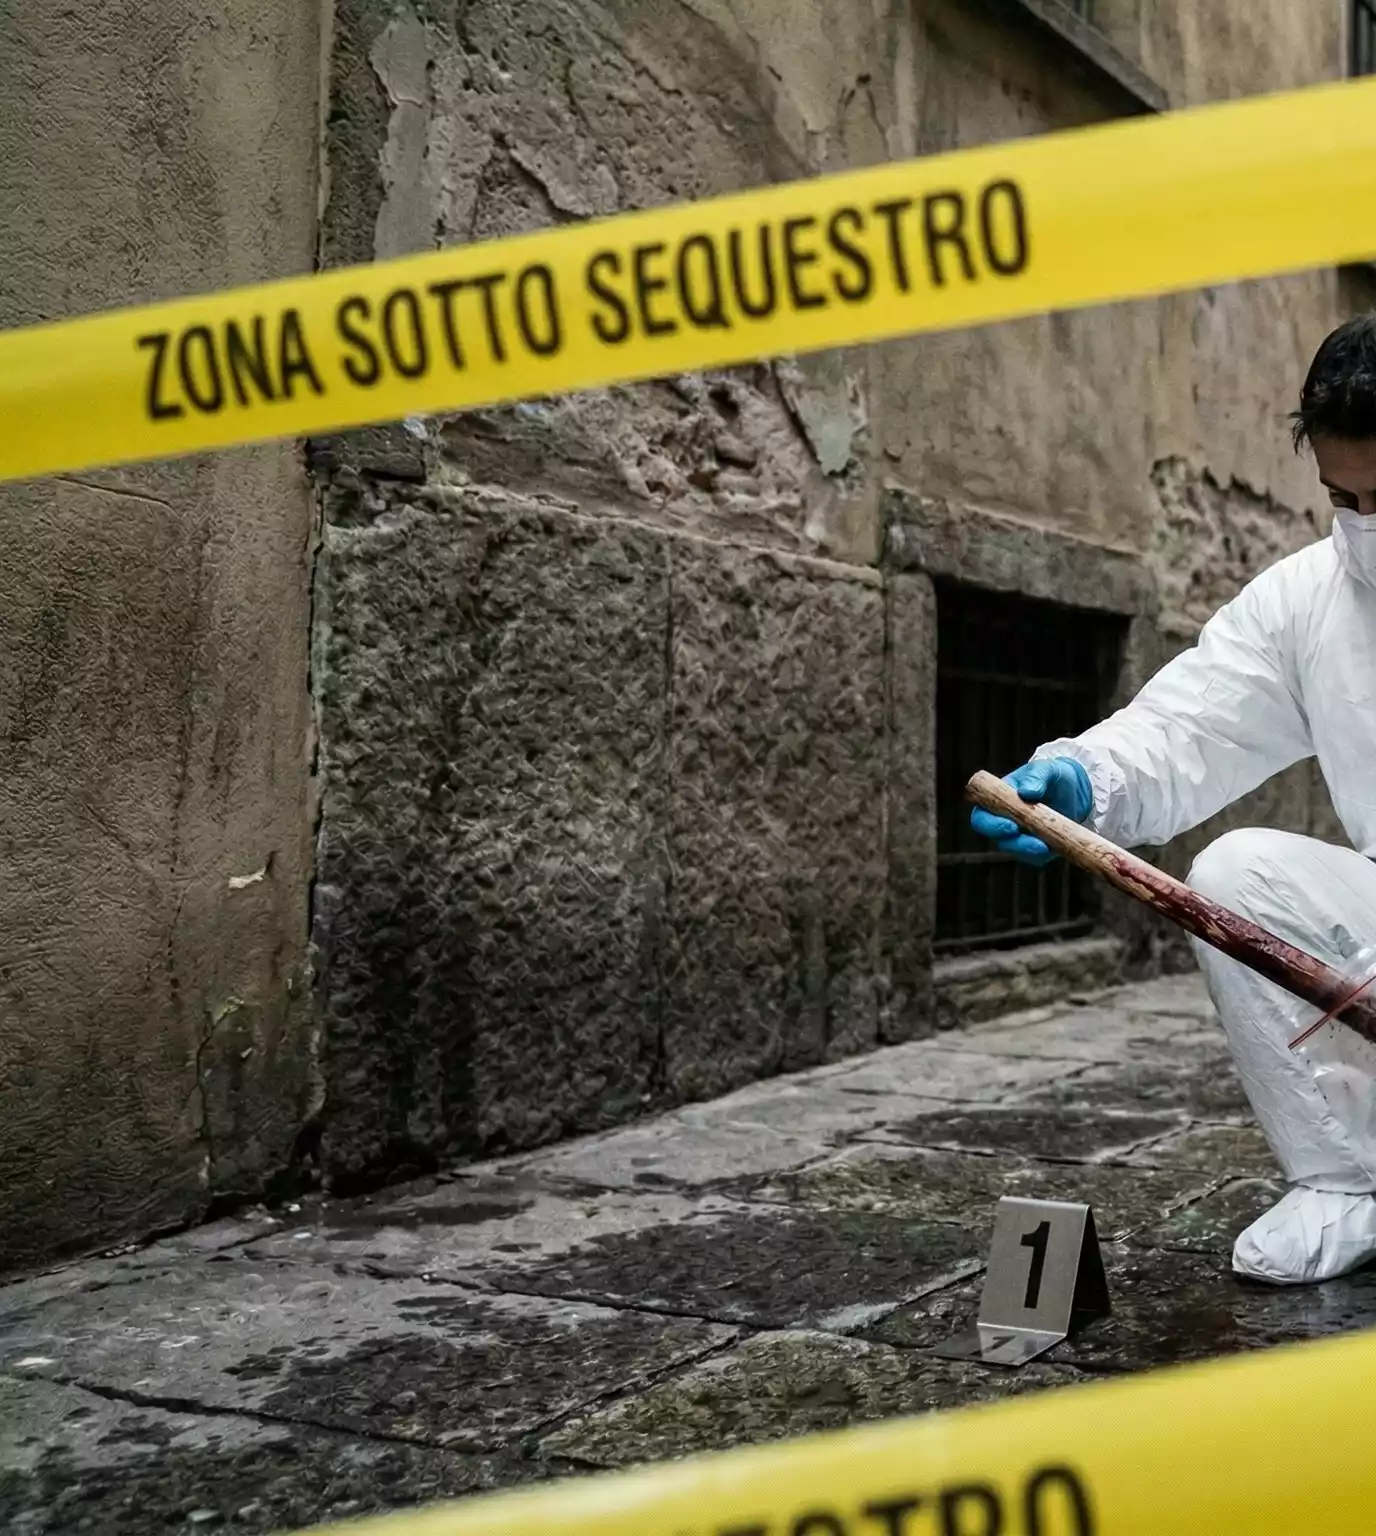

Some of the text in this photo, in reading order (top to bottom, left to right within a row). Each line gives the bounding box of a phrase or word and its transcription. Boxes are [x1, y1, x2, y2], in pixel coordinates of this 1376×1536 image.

[137, 178, 1029, 420] ZONA SOTTO SEQUESTRO
[1020, 1220, 1051, 1309] 1
